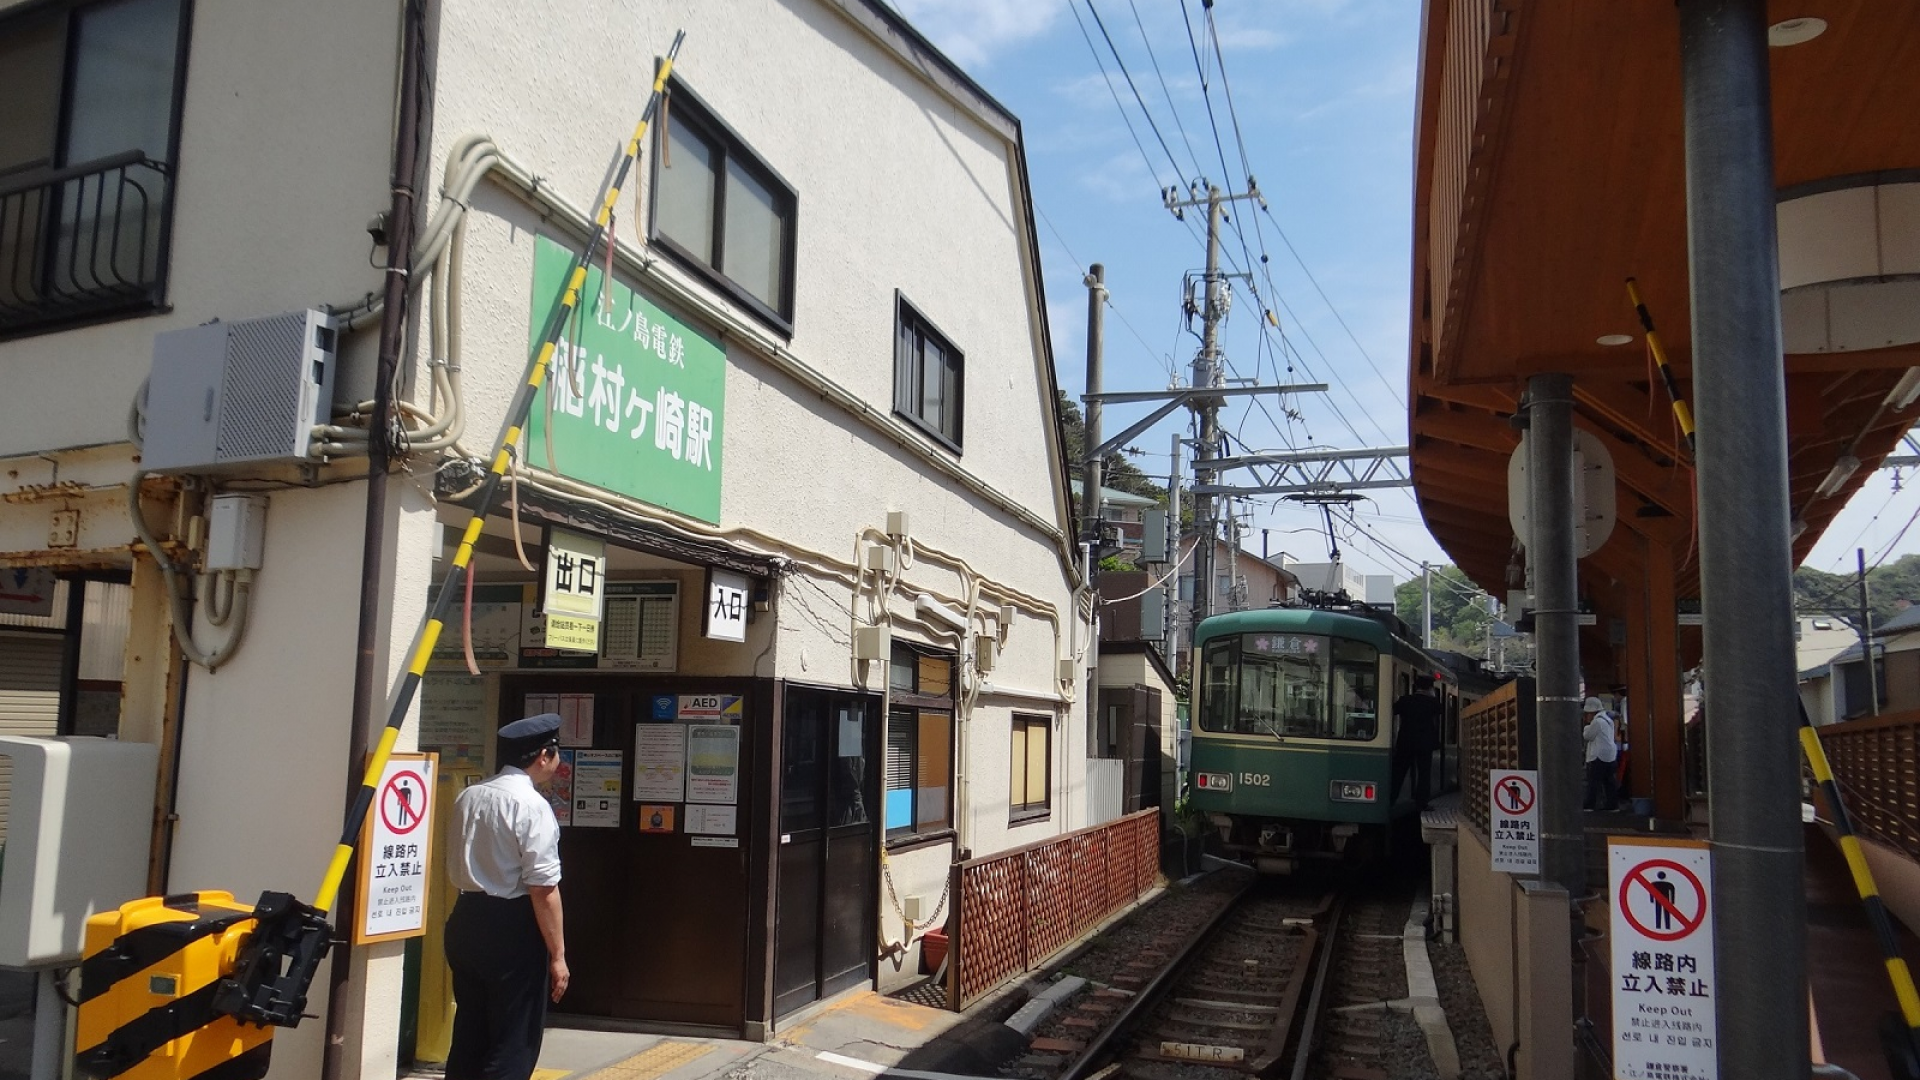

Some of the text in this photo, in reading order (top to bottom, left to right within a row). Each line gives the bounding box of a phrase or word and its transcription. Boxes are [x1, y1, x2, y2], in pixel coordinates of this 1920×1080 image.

[597, 291, 685, 369] 江ノ島電鉄
[556, 552, 596, 595] 出口
[714, 588, 741, 622] 入口
[692, 698, 717, 708] AED
[1238, 772, 1271, 787] 1502
[1495, 830, 1535, 840] 立入禁止
[383, 844, 418, 859] 線路内
[375, 861, 422, 878] 立入禁止
[383, 886, 399, 894] Keep
[1632, 951, 1697, 973] 線路内
[1621, 973, 1710, 998] 立入禁止
[1638, 1003, 1693, 1017] Keep Out
[1621, 1031, 1642, 1042] 선로
[1649, 1033, 1659, 1043] 내
